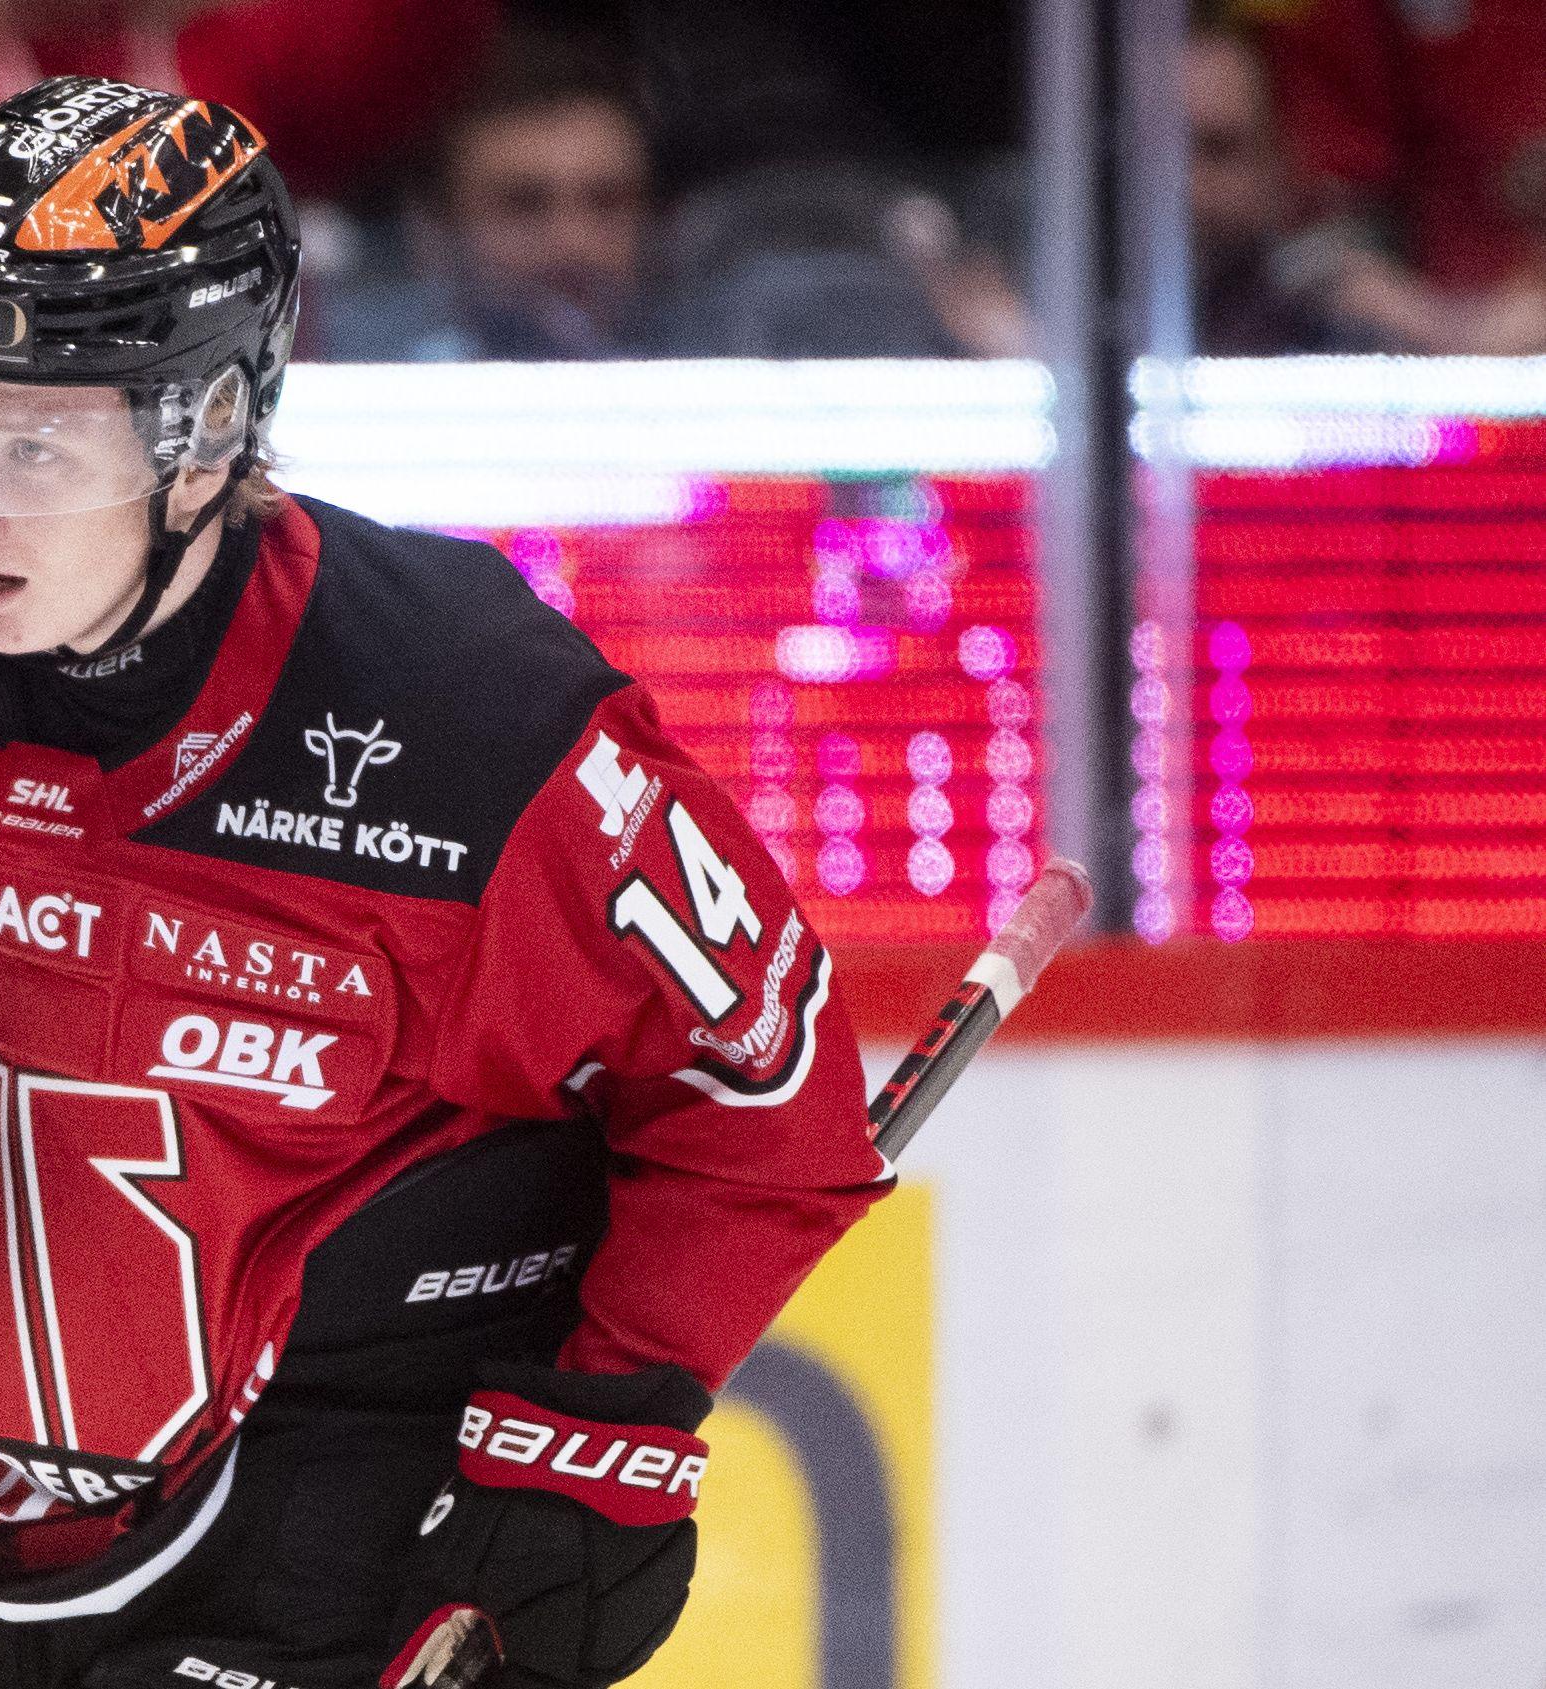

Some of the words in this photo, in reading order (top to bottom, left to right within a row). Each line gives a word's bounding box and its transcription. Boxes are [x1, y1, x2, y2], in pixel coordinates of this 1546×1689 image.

[7, 778, 74, 814] SHL
[143, 711, 253, 818] BYGGPRODUKTION
[216, 799, 344, 850] NÄRKE
[354, 822, 468, 872] KÖTT
[611, 795, 764, 1025] 14
[143, 912, 372, 997] NASTA
[160, 1014, 340, 1088] OBK
